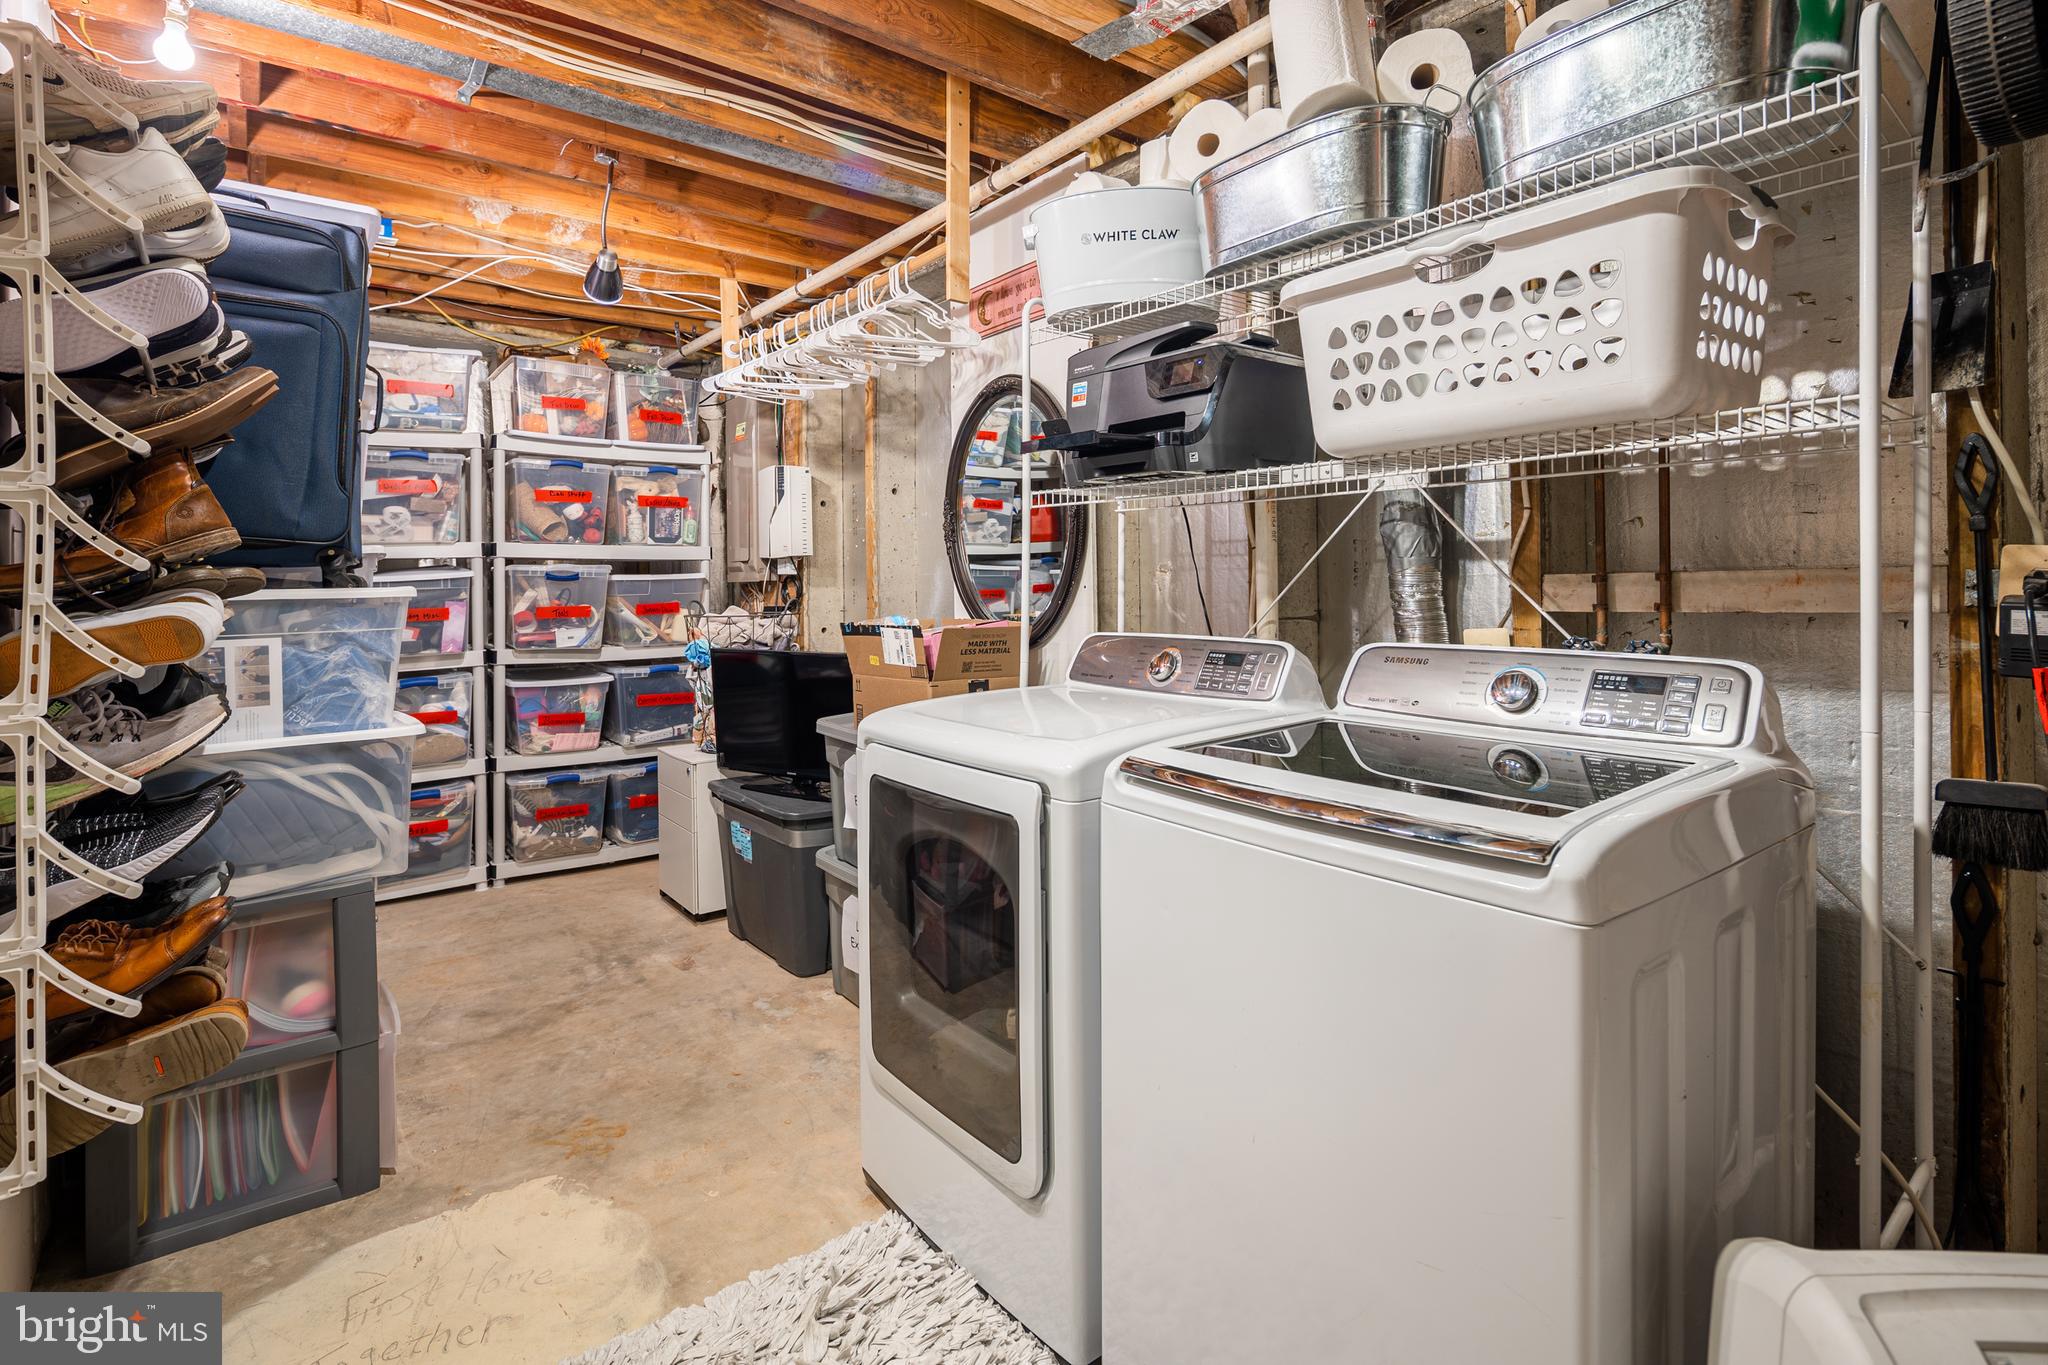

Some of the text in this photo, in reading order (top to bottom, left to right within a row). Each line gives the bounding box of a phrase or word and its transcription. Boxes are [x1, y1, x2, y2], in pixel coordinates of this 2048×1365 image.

[1093, 229, 1179, 242] WHITE CLAW
[978, 647, 1012, 655] MATERIAL
[1384, 656, 1430, 666] SAMSUNG
[340, 1262, 553, 1333] First Home
